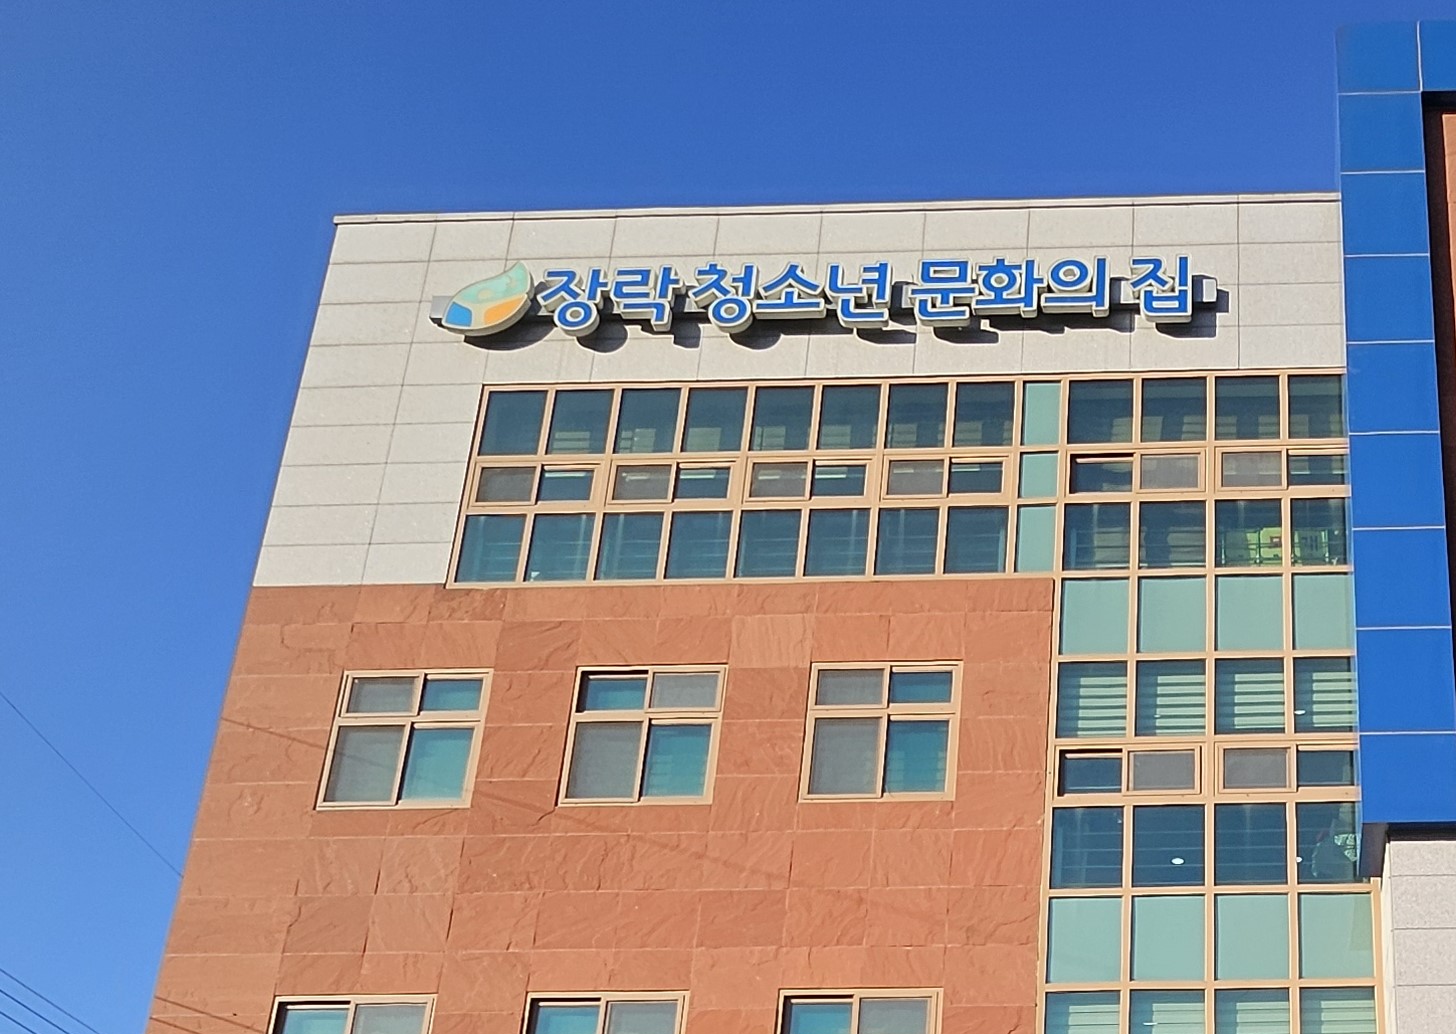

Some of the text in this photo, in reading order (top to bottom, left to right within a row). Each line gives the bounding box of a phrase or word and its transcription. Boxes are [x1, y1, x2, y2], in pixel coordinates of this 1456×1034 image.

[538, 254, 1191, 331] 장락 청소년 문화의 집
